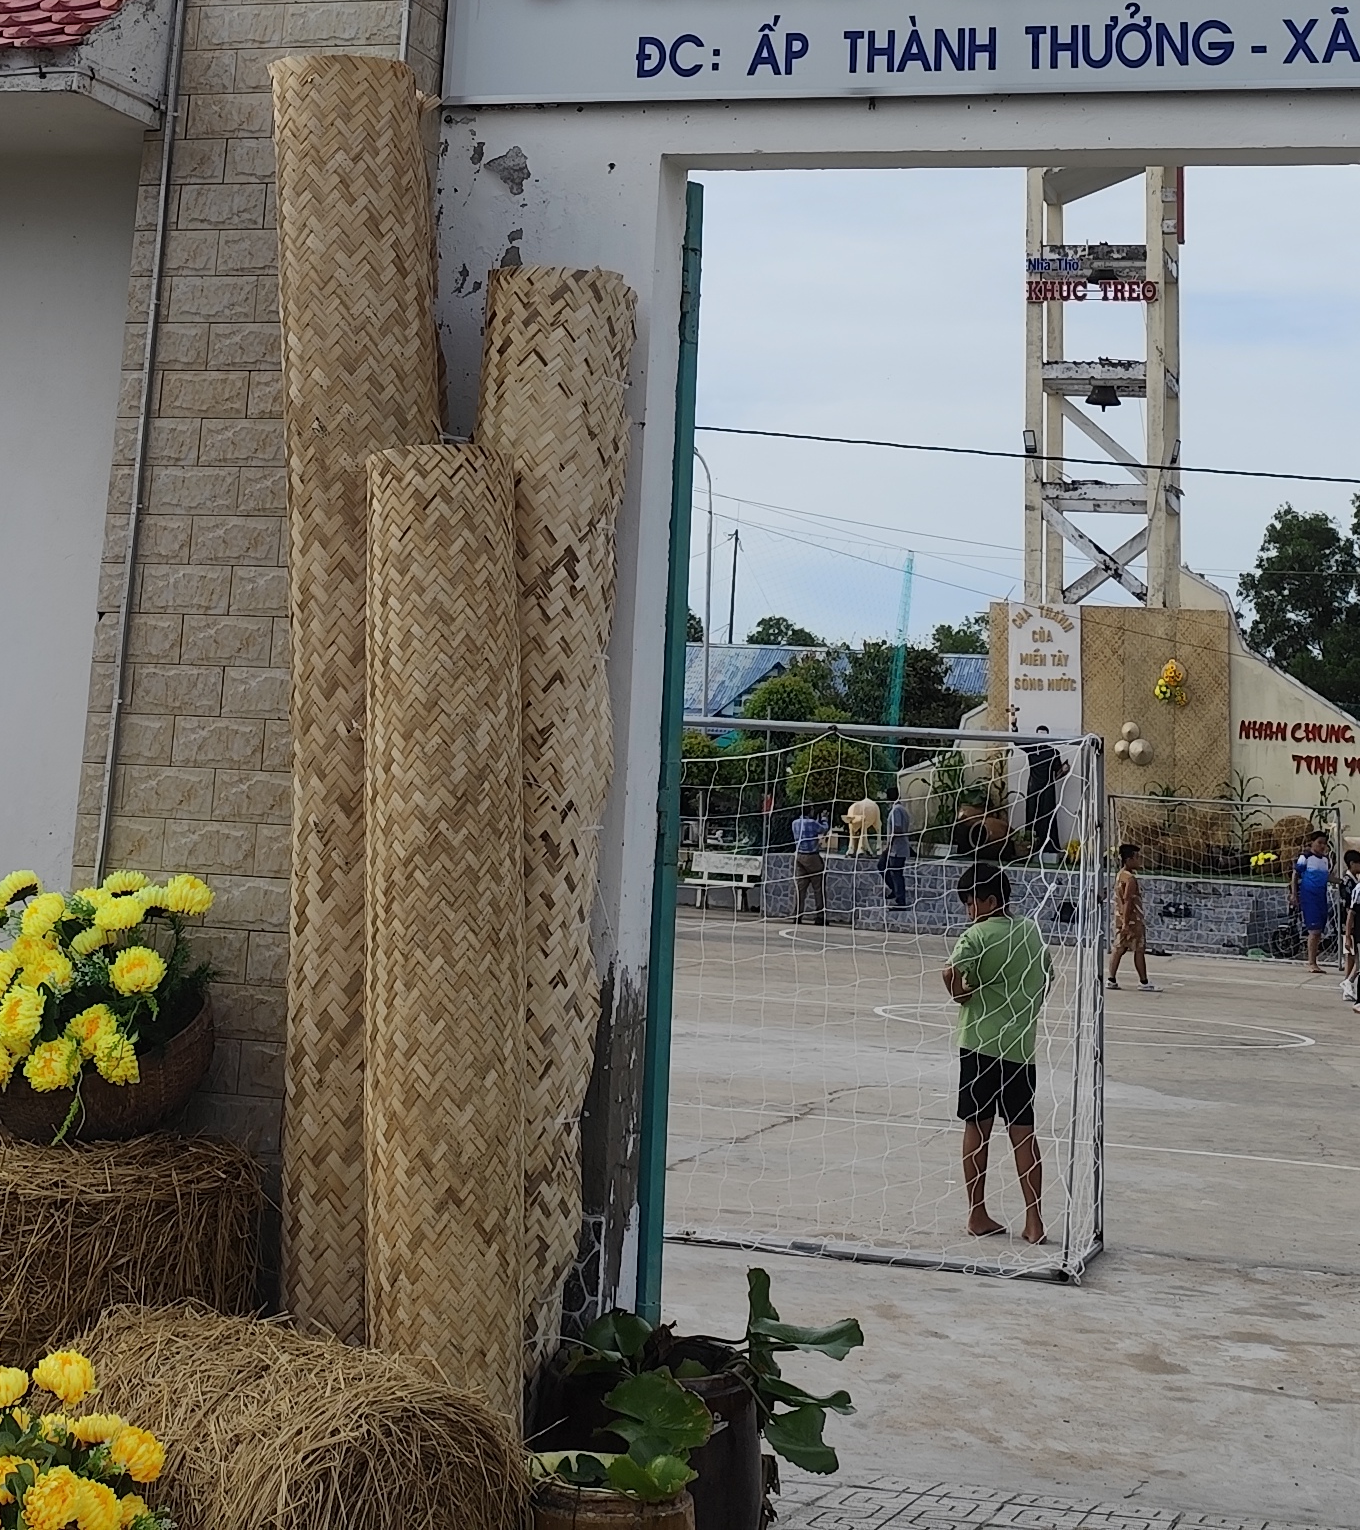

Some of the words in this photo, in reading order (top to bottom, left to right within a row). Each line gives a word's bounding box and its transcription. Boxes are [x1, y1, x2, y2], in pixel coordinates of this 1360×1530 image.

[635, 32, 722, 79] ĐC:
[747, 13, 809, 76] ẤP
[844, 15, 998, 73] THÀNH
[1024, 1, 1235, 69] THƯỞNG
[1281, 5, 1360, 65] XÃ
[1027, 274, 1088, 301] KHÚC
[1099, 274, 1157, 301] TRÉO
